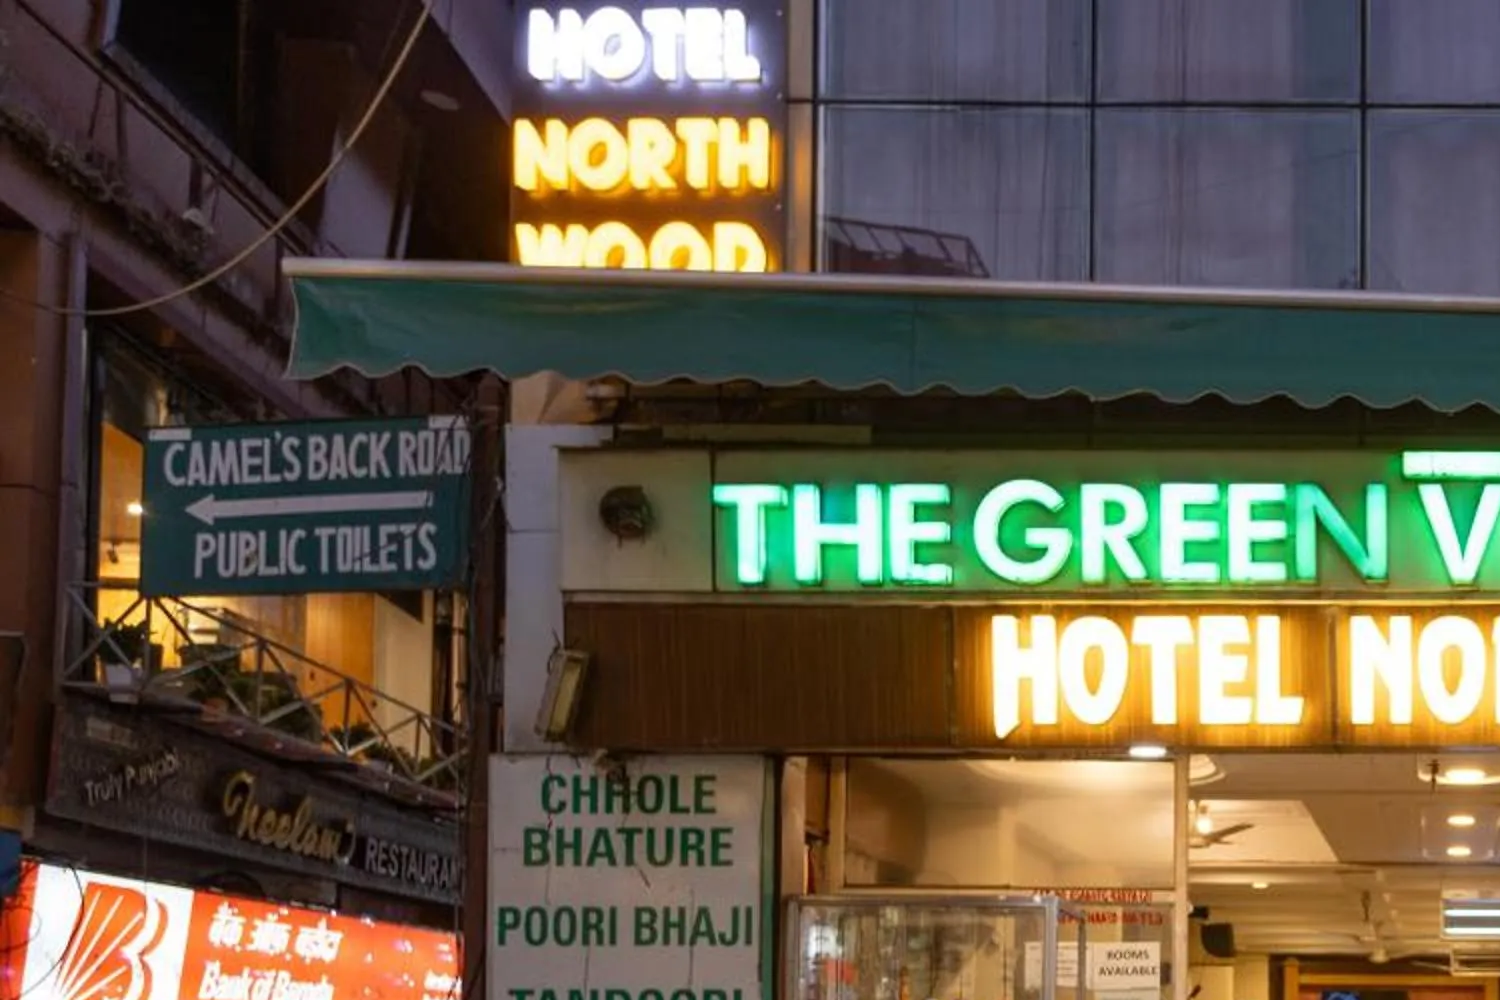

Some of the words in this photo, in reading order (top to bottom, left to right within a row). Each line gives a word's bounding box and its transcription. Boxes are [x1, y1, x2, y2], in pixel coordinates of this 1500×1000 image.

[526, 7, 762, 83] HOTEL
[513, 117, 773, 193] NORTH
[515, 222, 769, 272] WOOD
[163, 431, 301, 487] CAMEL'S
[308, 431, 392, 482] BACK
[398, 429, 471, 477] ROAD
[194, 529, 307, 579] PUBLIC
[314, 523, 438, 574] TOILETS
[713, 482, 954, 586] THE
[972, 479, 1389, 586] GREEN
[991, 614, 1305, 740] HOTEL
[541, 774, 717, 815] CHHOLE
[523, 827, 734, 867] BHATURE
[497, 906, 617, 946] POORI
[634, 905, 753, 946] BHAJI
[1098, 965, 1158, 976] AVAILABLE
[1107, 949, 1150, 961] ROOMS
